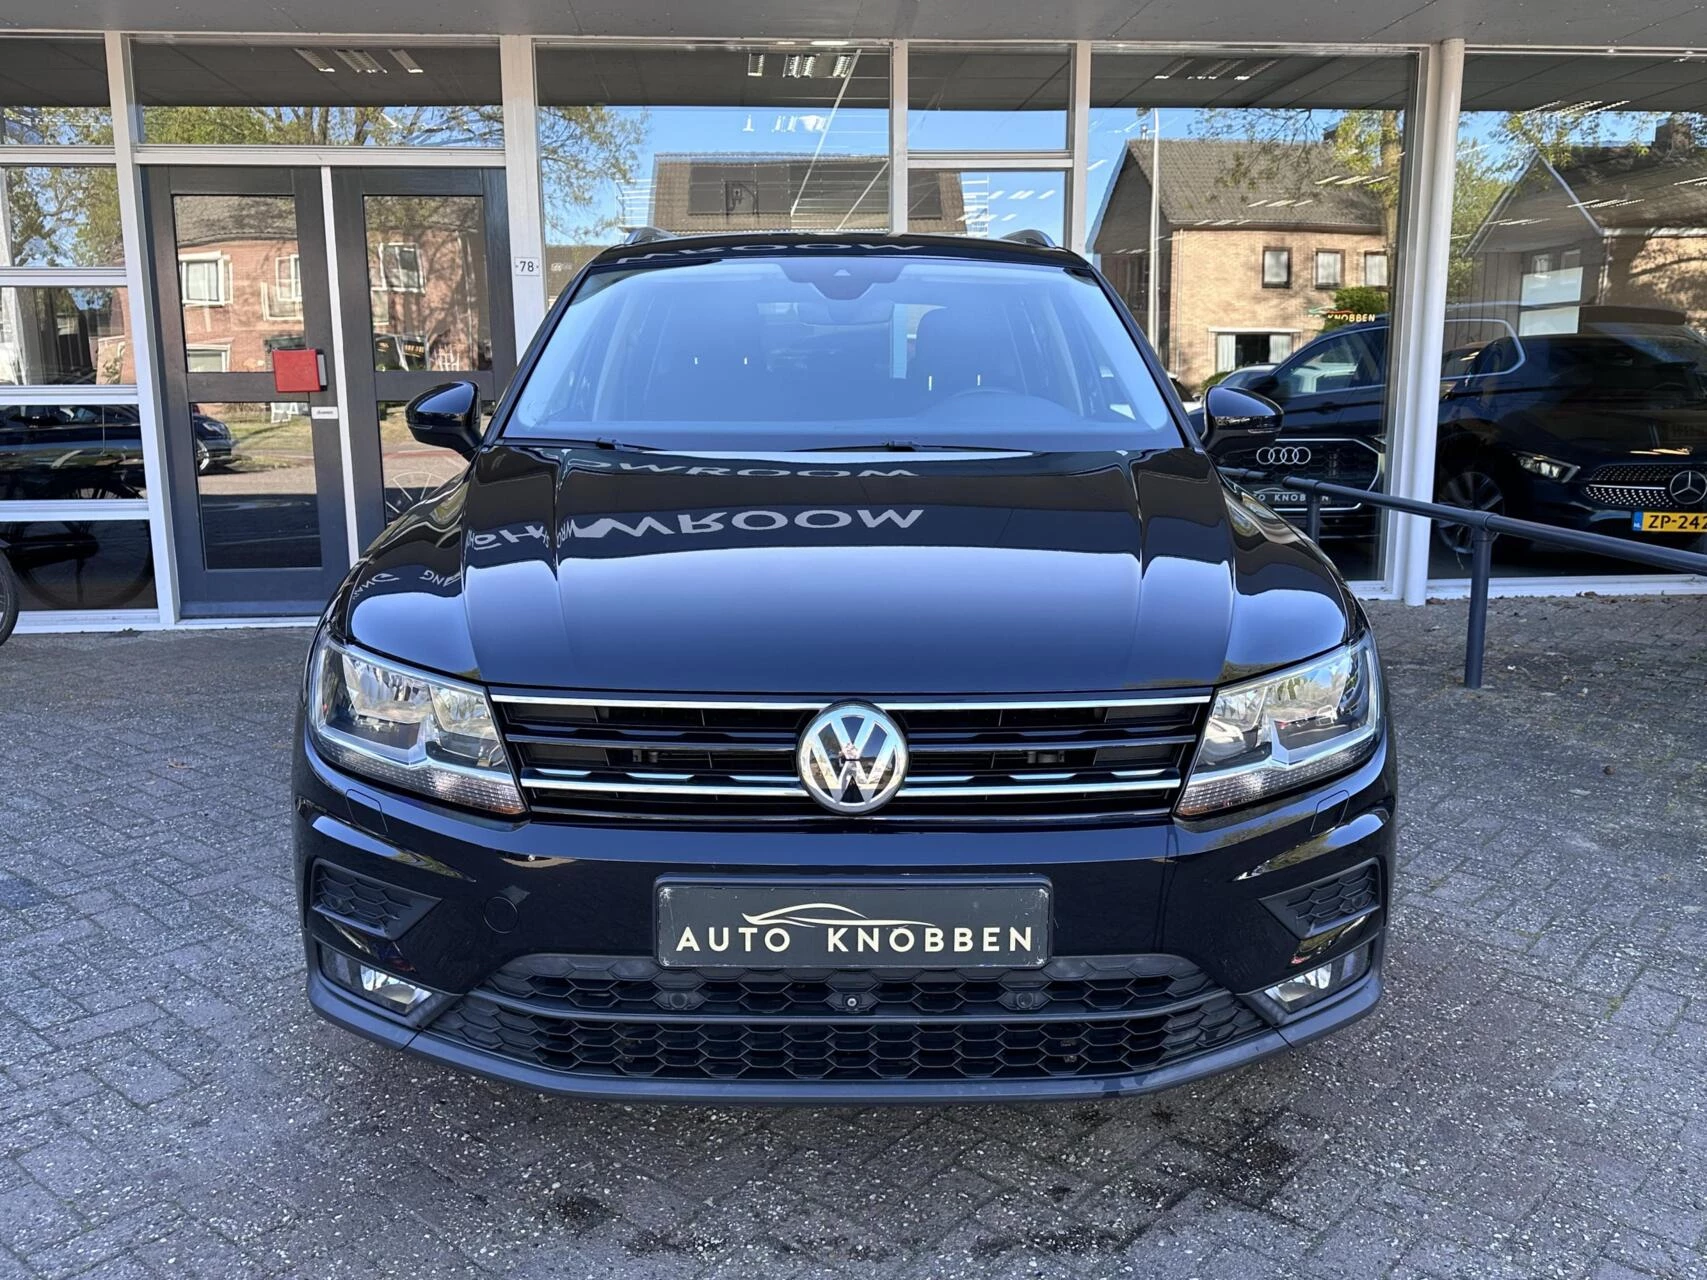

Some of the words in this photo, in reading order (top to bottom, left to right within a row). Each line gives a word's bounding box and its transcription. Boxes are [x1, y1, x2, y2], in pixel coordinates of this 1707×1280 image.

[519, 260, 534, 272] 78
[676, 926, 790, 952] AUTO
[827, 926, 1033, 953] KNOBBEN
